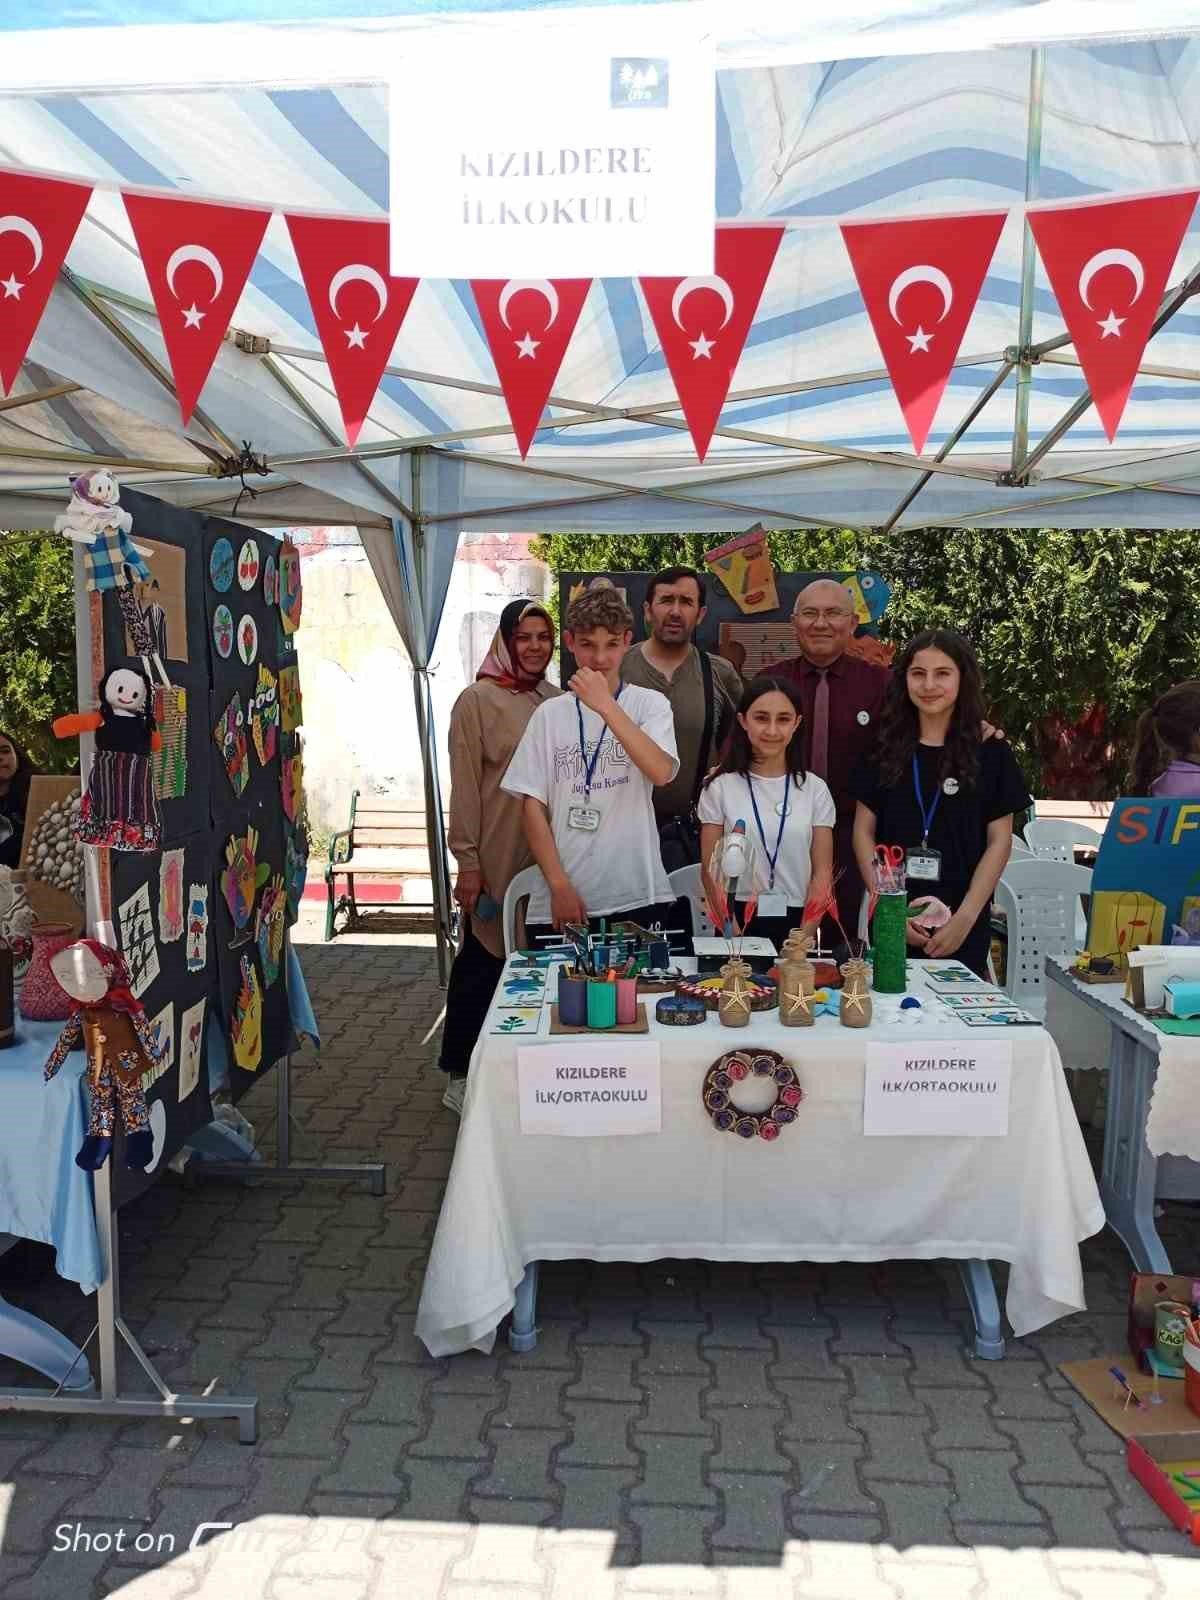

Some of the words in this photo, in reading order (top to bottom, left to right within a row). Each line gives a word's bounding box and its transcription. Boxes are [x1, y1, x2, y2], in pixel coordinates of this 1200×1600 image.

[459, 146, 652, 178] KIZILDERE
[462, 193, 649, 225] İLKOKULU
[904, 1058, 977, 1071] KIZILDERE
[555, 1066, 628, 1080] KIZILDERE
[535, 1089, 648, 1105] İLK/ORTAOKULU
